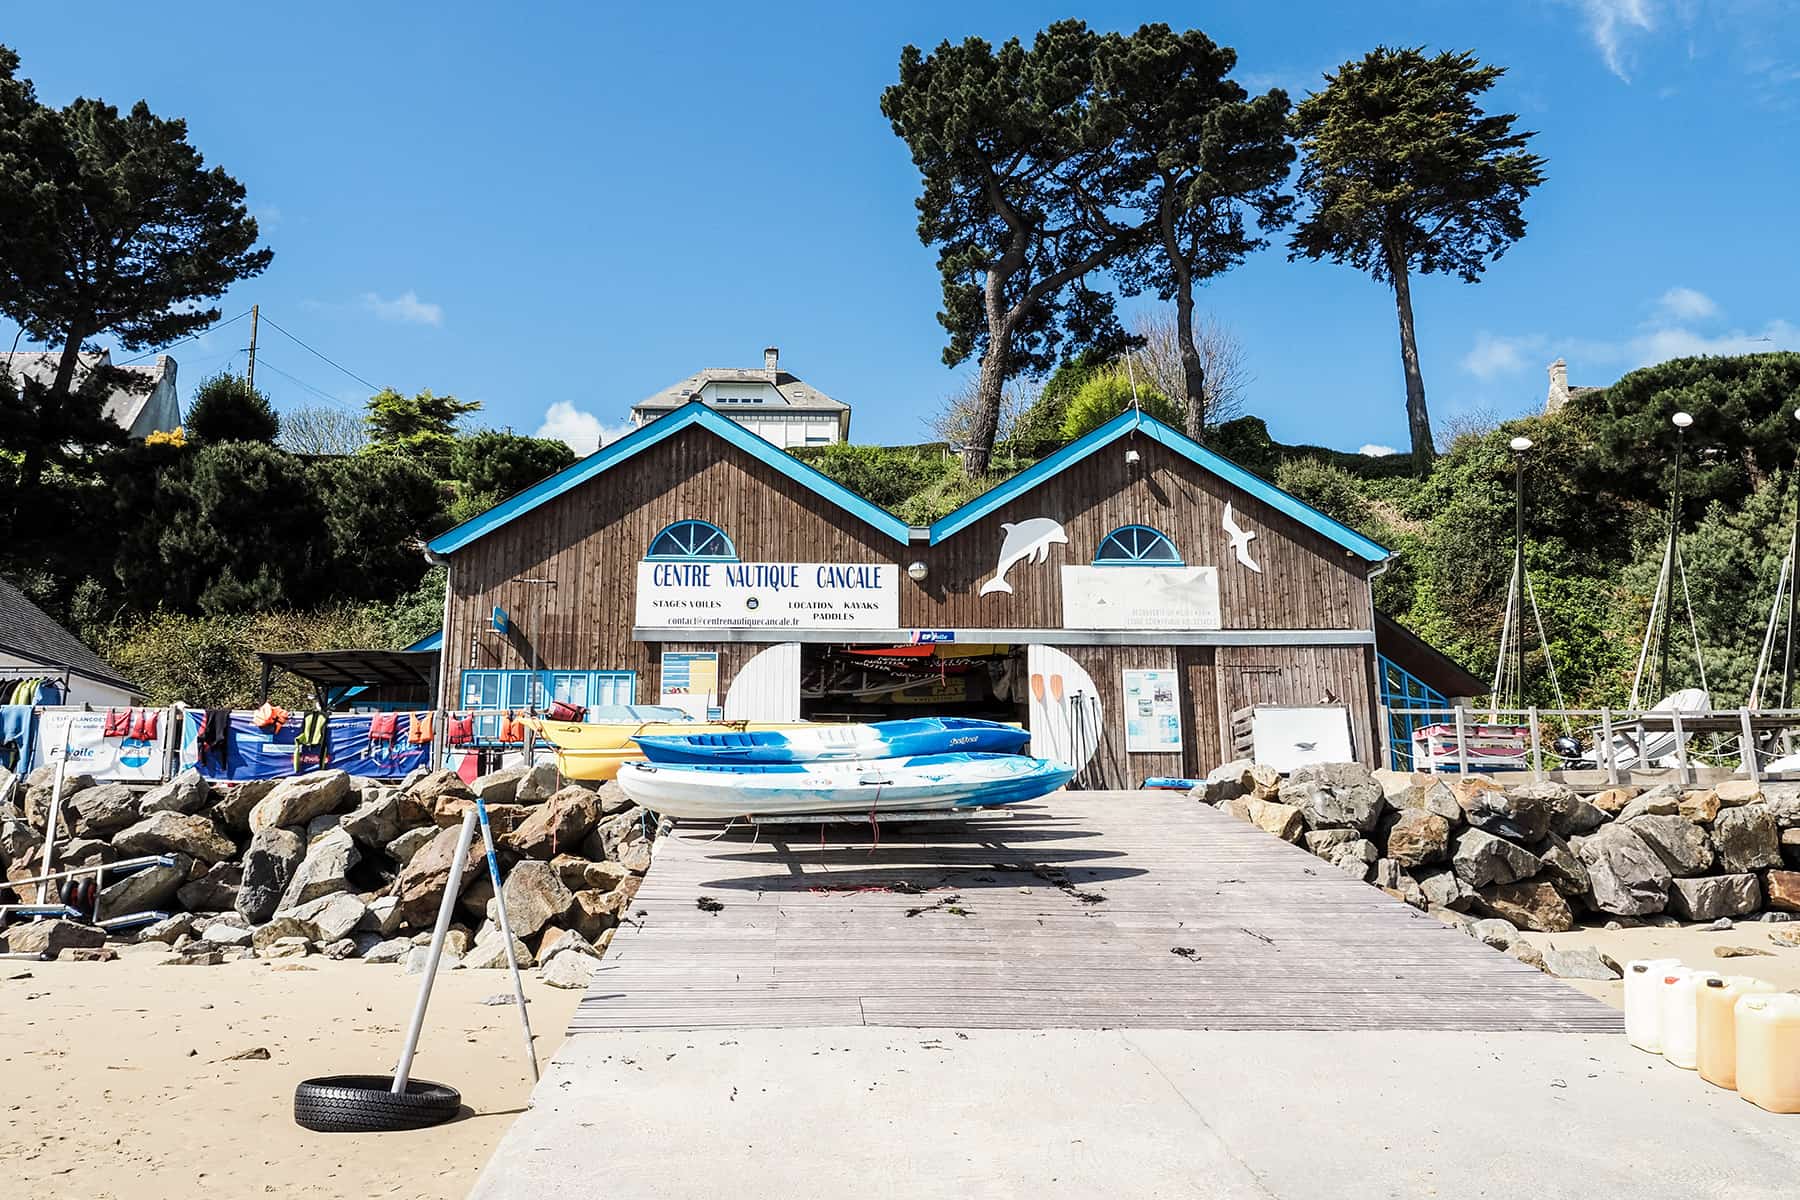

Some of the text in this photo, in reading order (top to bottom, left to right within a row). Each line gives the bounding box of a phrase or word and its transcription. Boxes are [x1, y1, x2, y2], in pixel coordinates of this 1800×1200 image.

[653, 564, 882, 591] CENTRE NAUTIQUE CANCALE
[652, 600, 722, 609] STAGES VOILES
[787, 601, 879, 609] LOCATION KAYAKS
[813, 612, 855, 620] PADDLES
